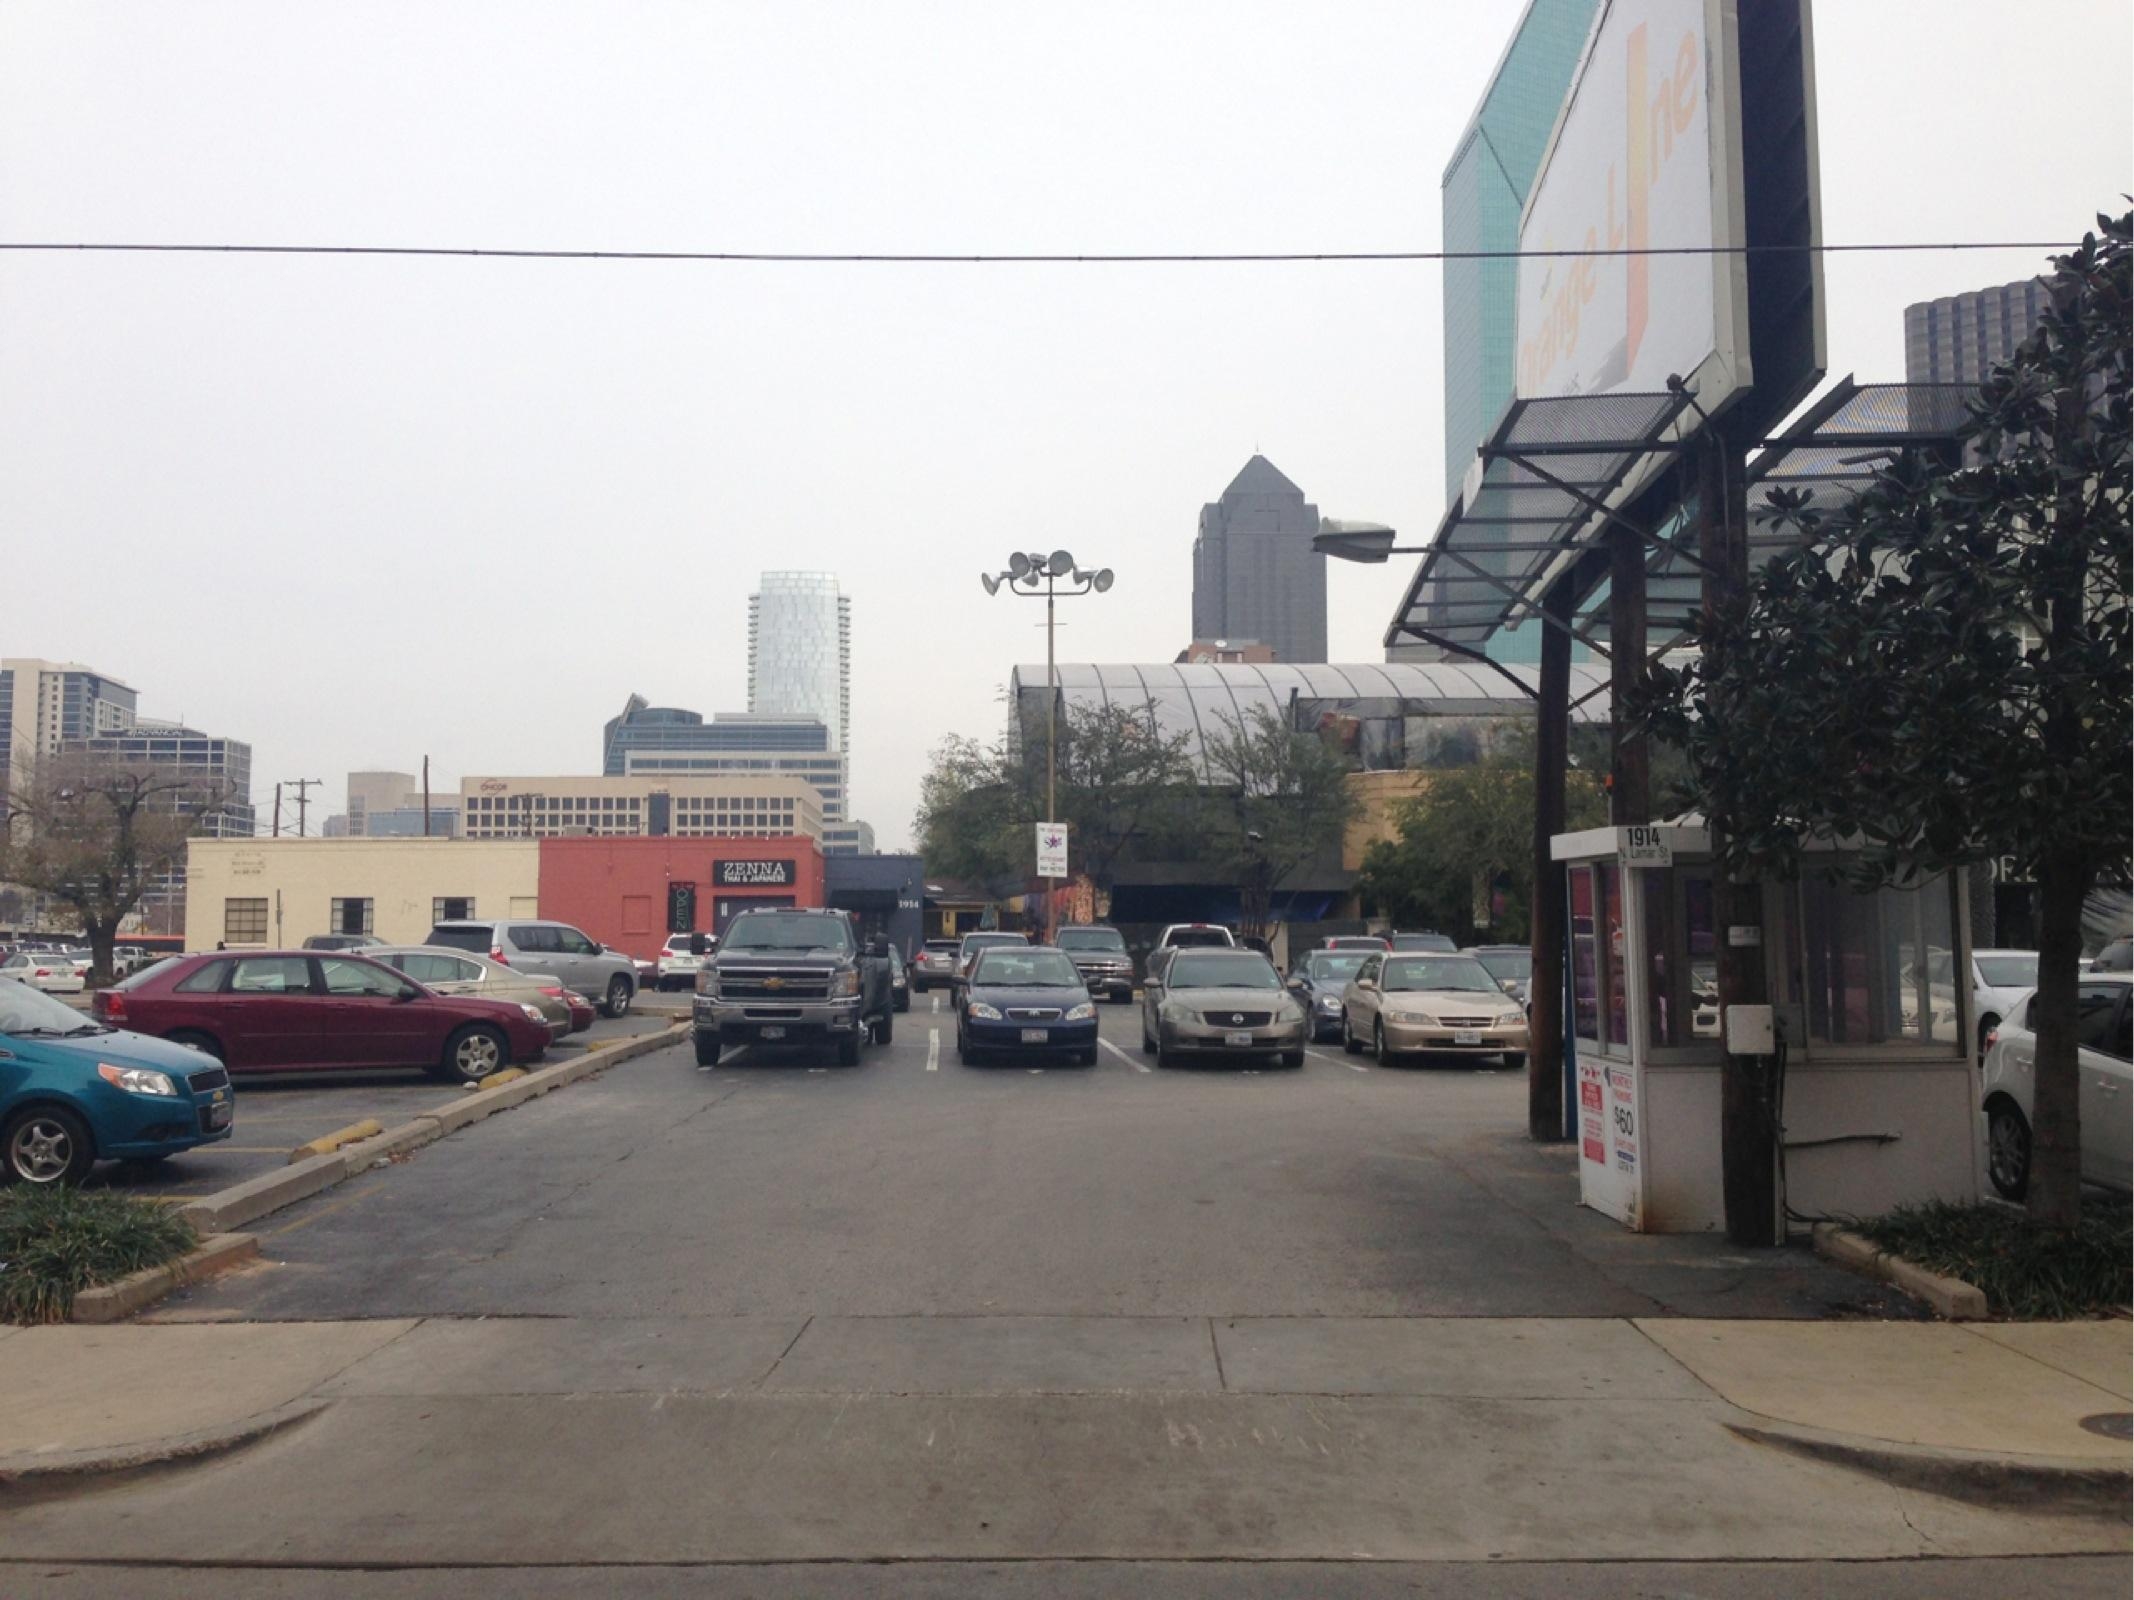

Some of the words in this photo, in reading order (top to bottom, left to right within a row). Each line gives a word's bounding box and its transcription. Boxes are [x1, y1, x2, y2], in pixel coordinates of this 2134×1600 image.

[1627, 827, 1661, 847] 1914
[1631, 846, 1657, 860] Lamar
[723, 861, 786, 875] ZENNA
[1614, 1105, 1634, 1137] $60
